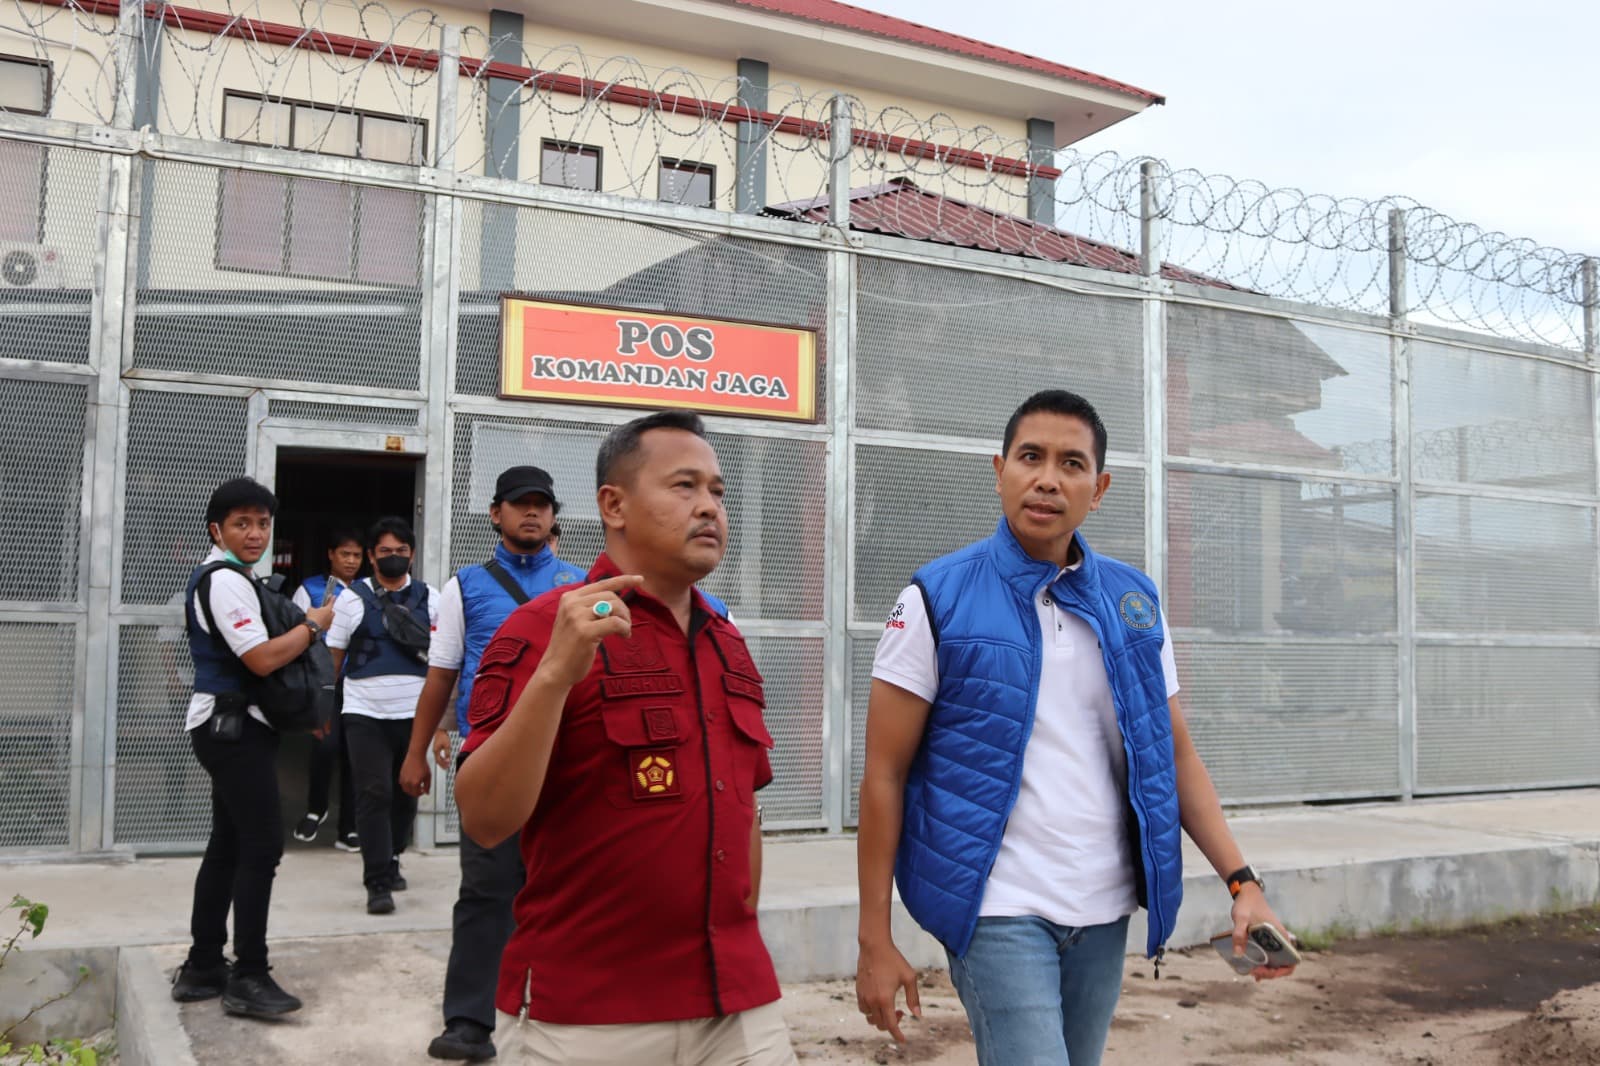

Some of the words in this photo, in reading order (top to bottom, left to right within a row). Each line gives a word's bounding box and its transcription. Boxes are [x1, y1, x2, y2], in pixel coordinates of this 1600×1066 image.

[617, 320, 714, 361] POS
[531, 356, 706, 389] KOMANDAN
[712, 373, 788, 399] JAGA
